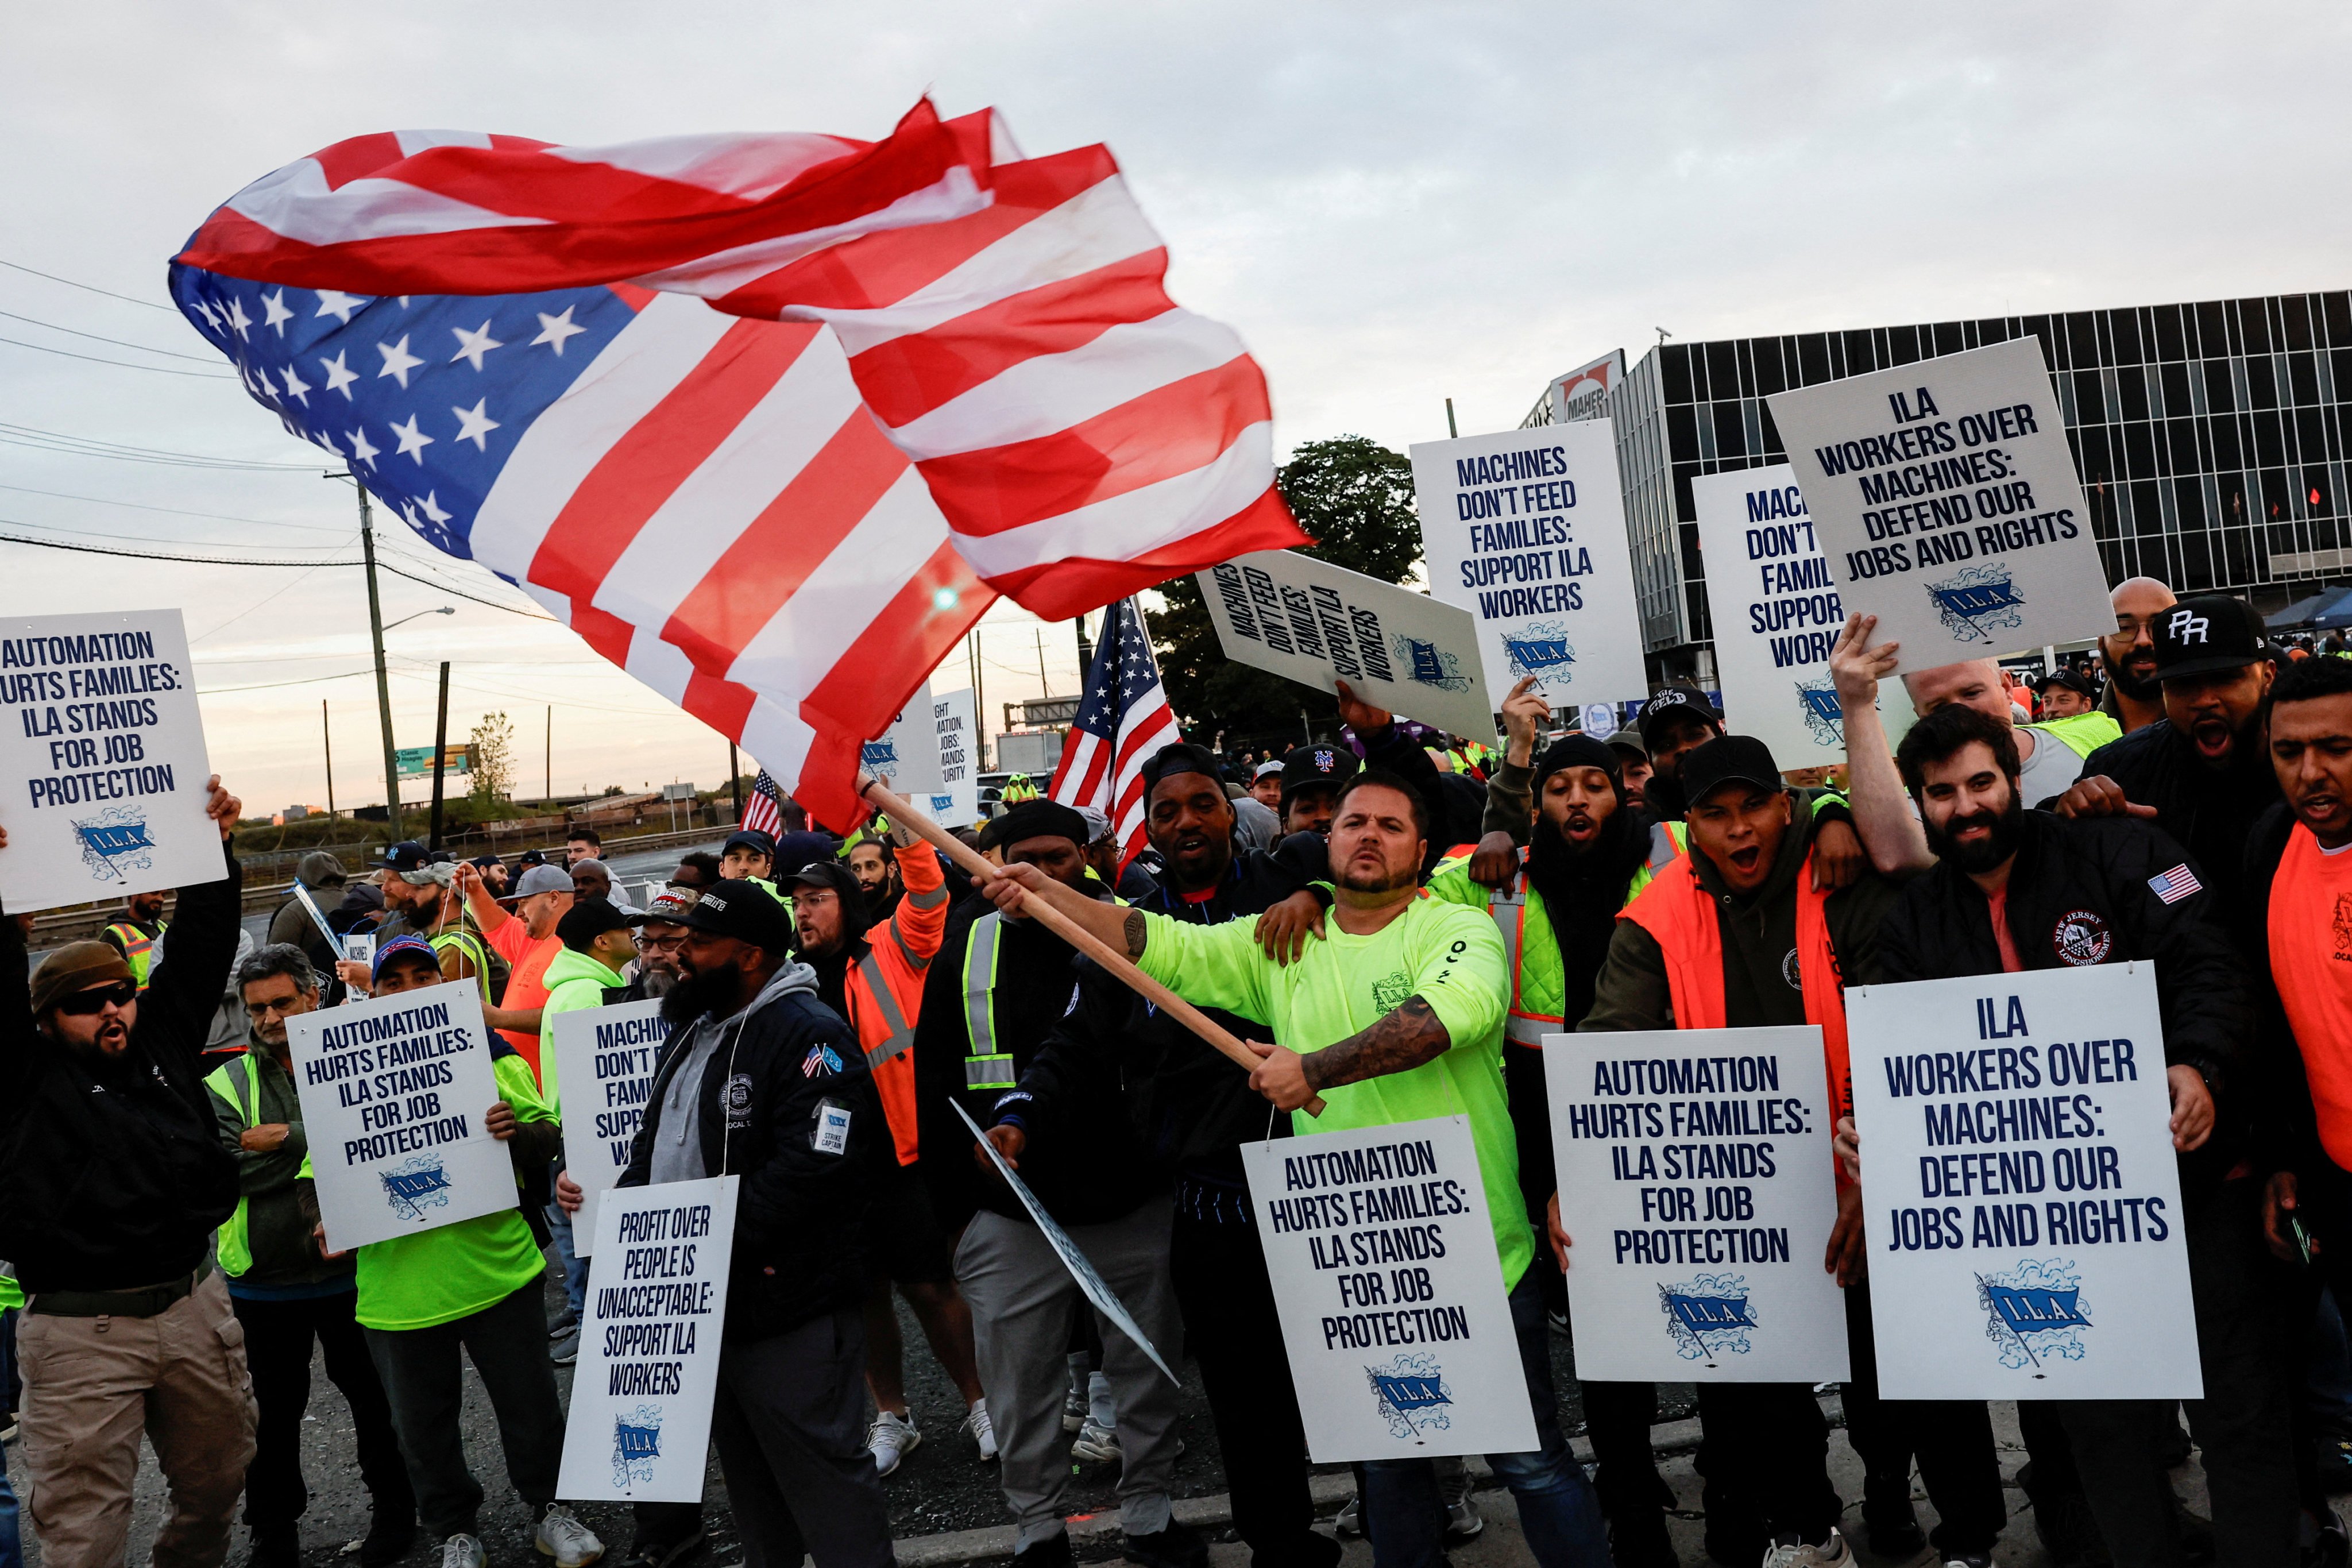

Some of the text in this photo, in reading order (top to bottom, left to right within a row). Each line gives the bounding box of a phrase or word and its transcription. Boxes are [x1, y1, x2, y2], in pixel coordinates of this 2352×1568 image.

[1567, 388, 1604, 420] MAHER
[1888, 387, 1940, 424] ILA
[1815, 404, 2038, 477] WORKERS OVER
[1457, 446, 1567, 486] MACHINES
[1859, 449, 2016, 505] MACHINES:
[1457, 480, 1576, 520] DON'T FEED
[1862, 481, 2036, 541] DEFEND OUR
[1470, 516, 1573, 553] FAMILIES:
[1846, 509, 2077, 581] JOBS AND RIGHTS
[1461, 547, 1593, 588] SUPPORT ILA
[1761, 557, 1834, 596] FAMIL
[1212, 563, 1262, 642] MACHINES
[1242, 566, 1295, 655] DON'T FEED
[1478, 582, 1582, 619] WORKERS
[1749, 593, 1845, 634] SUPPOR
[1953, 587, 2012, 611] I.L.A.
[1280, 585, 1327, 660] FAMILIES:
[1310, 585, 1363, 680] SUPPORT ILA
[2168, 609, 2209, 645] PR
[3, 631, 154, 668] AUTOMATION
[1348, 606, 1393, 682] WORKERS
[1517, 645, 1566, 662] I.L.A.
[0, 663, 181, 704] URTS FAMILIES:
[1654, 689, 1674, 699] THE
[22, 698, 157, 737] ILA STANDS
[933, 702, 949, 718] GHT
[50, 734, 144, 770] FOR JOB
[940, 733, 959, 750] JOBS:
[29, 764, 175, 808] PROTECTION
[943, 765, 965, 782] URITY
[92, 831, 145, 848] I.L.A.
[2055, 912, 2102, 943] NEW JERSEY
[2059, 930, 2110, 966] LONGSHOREMEN
[322, 1003, 450, 1053] AUTOMATION
[596, 1016, 672, 1049] MACHIN
[1977, 996, 2029, 1040] ILA
[306, 1028, 473, 1085] HURTS FAMILIES:
[595, 1048, 649, 1079] DON'T
[1884, 1046, 2041, 1097] WORKERS
[2048, 1039, 2137, 1086] OVER
[338, 1061, 453, 1107] ILA STANDS
[1594, 1056, 1779, 1096] AUTOMATION
[361, 1093, 441, 1131] FOR JOB
[1570, 1099, 1812, 1138] HURTS FAMILIES:
[1925, 1094, 2104, 1146] MACHINES:
[345, 1115, 468, 1165] PROTECTION
[821, 1140, 842, 1149] CAPTAIN
[824, 1133, 842, 1142] STRIKE
[1285, 1140, 1437, 1191] AUTOMATION
[1612, 1142, 1775, 1180] ILA STANDS
[1920, 1146, 2122, 1198] DEFEND OUR
[398, 1175, 442, 1196] I.L.A.
[1641, 1187, 1754, 1222] FOR JOB
[619, 1205, 710, 1243] PROFIT OVER
[1269, 1180, 1470, 1233] HURTS FAMILIES:
[1889, 1197, 2168, 1251] JOBS AND RIGHTS
[624, 1244, 696, 1280] PEOPLE IS
[1309, 1224, 1445, 1269] ILA STANDS
[1615, 1228, 1789, 1264] PROTECTION
[597, 1282, 713, 1319] UNACCEPTABLE:
[1338, 1268, 1434, 1308] FOR JOB
[1322, 1306, 1469, 1350] PROTECTION
[1683, 1303, 1745, 1322] I.L.A.
[2000, 1296, 2077, 1322] I.L.A.
[604, 1322, 695, 1357] SUPPORT ILA
[609, 1362, 682, 1395] WORKERS
[1387, 1382, 1442, 1401] I.L.A.
[625, 1431, 655, 1451] I.L.A.
